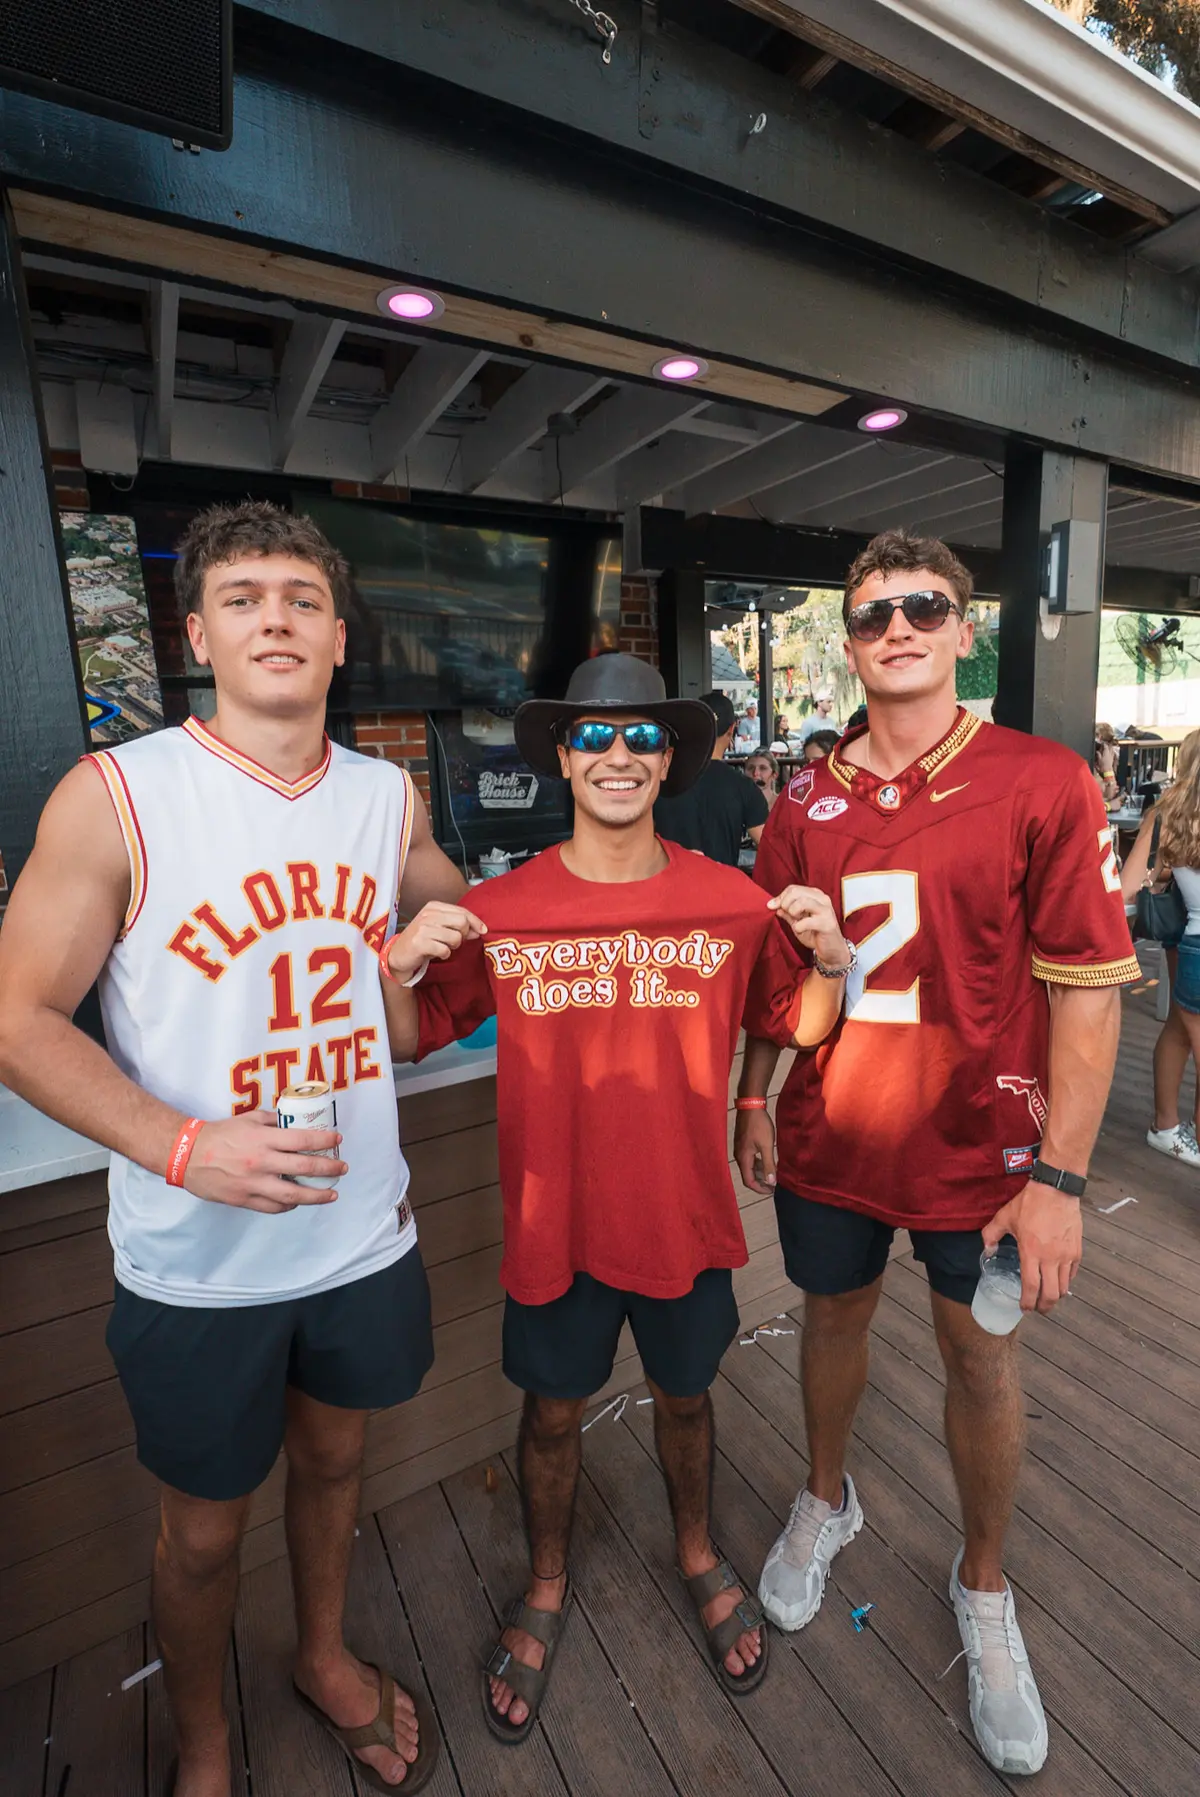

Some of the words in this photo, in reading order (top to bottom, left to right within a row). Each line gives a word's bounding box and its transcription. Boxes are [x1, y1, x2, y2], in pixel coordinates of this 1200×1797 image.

[478, 771, 520, 787] Brick
[478, 782, 528, 799] House
[810, 801, 844, 818] ACC
[1097, 826, 1122, 893] 2
[165, 860, 391, 984] FLORIDA
[841, 869, 921, 1024] 2
[485, 930, 734, 979] Everybody
[268, 944, 352, 1033] 12
[517, 974, 617, 1015] does
[630, 966, 700, 1007] it...
[230, 1026, 381, 1116] STATE
